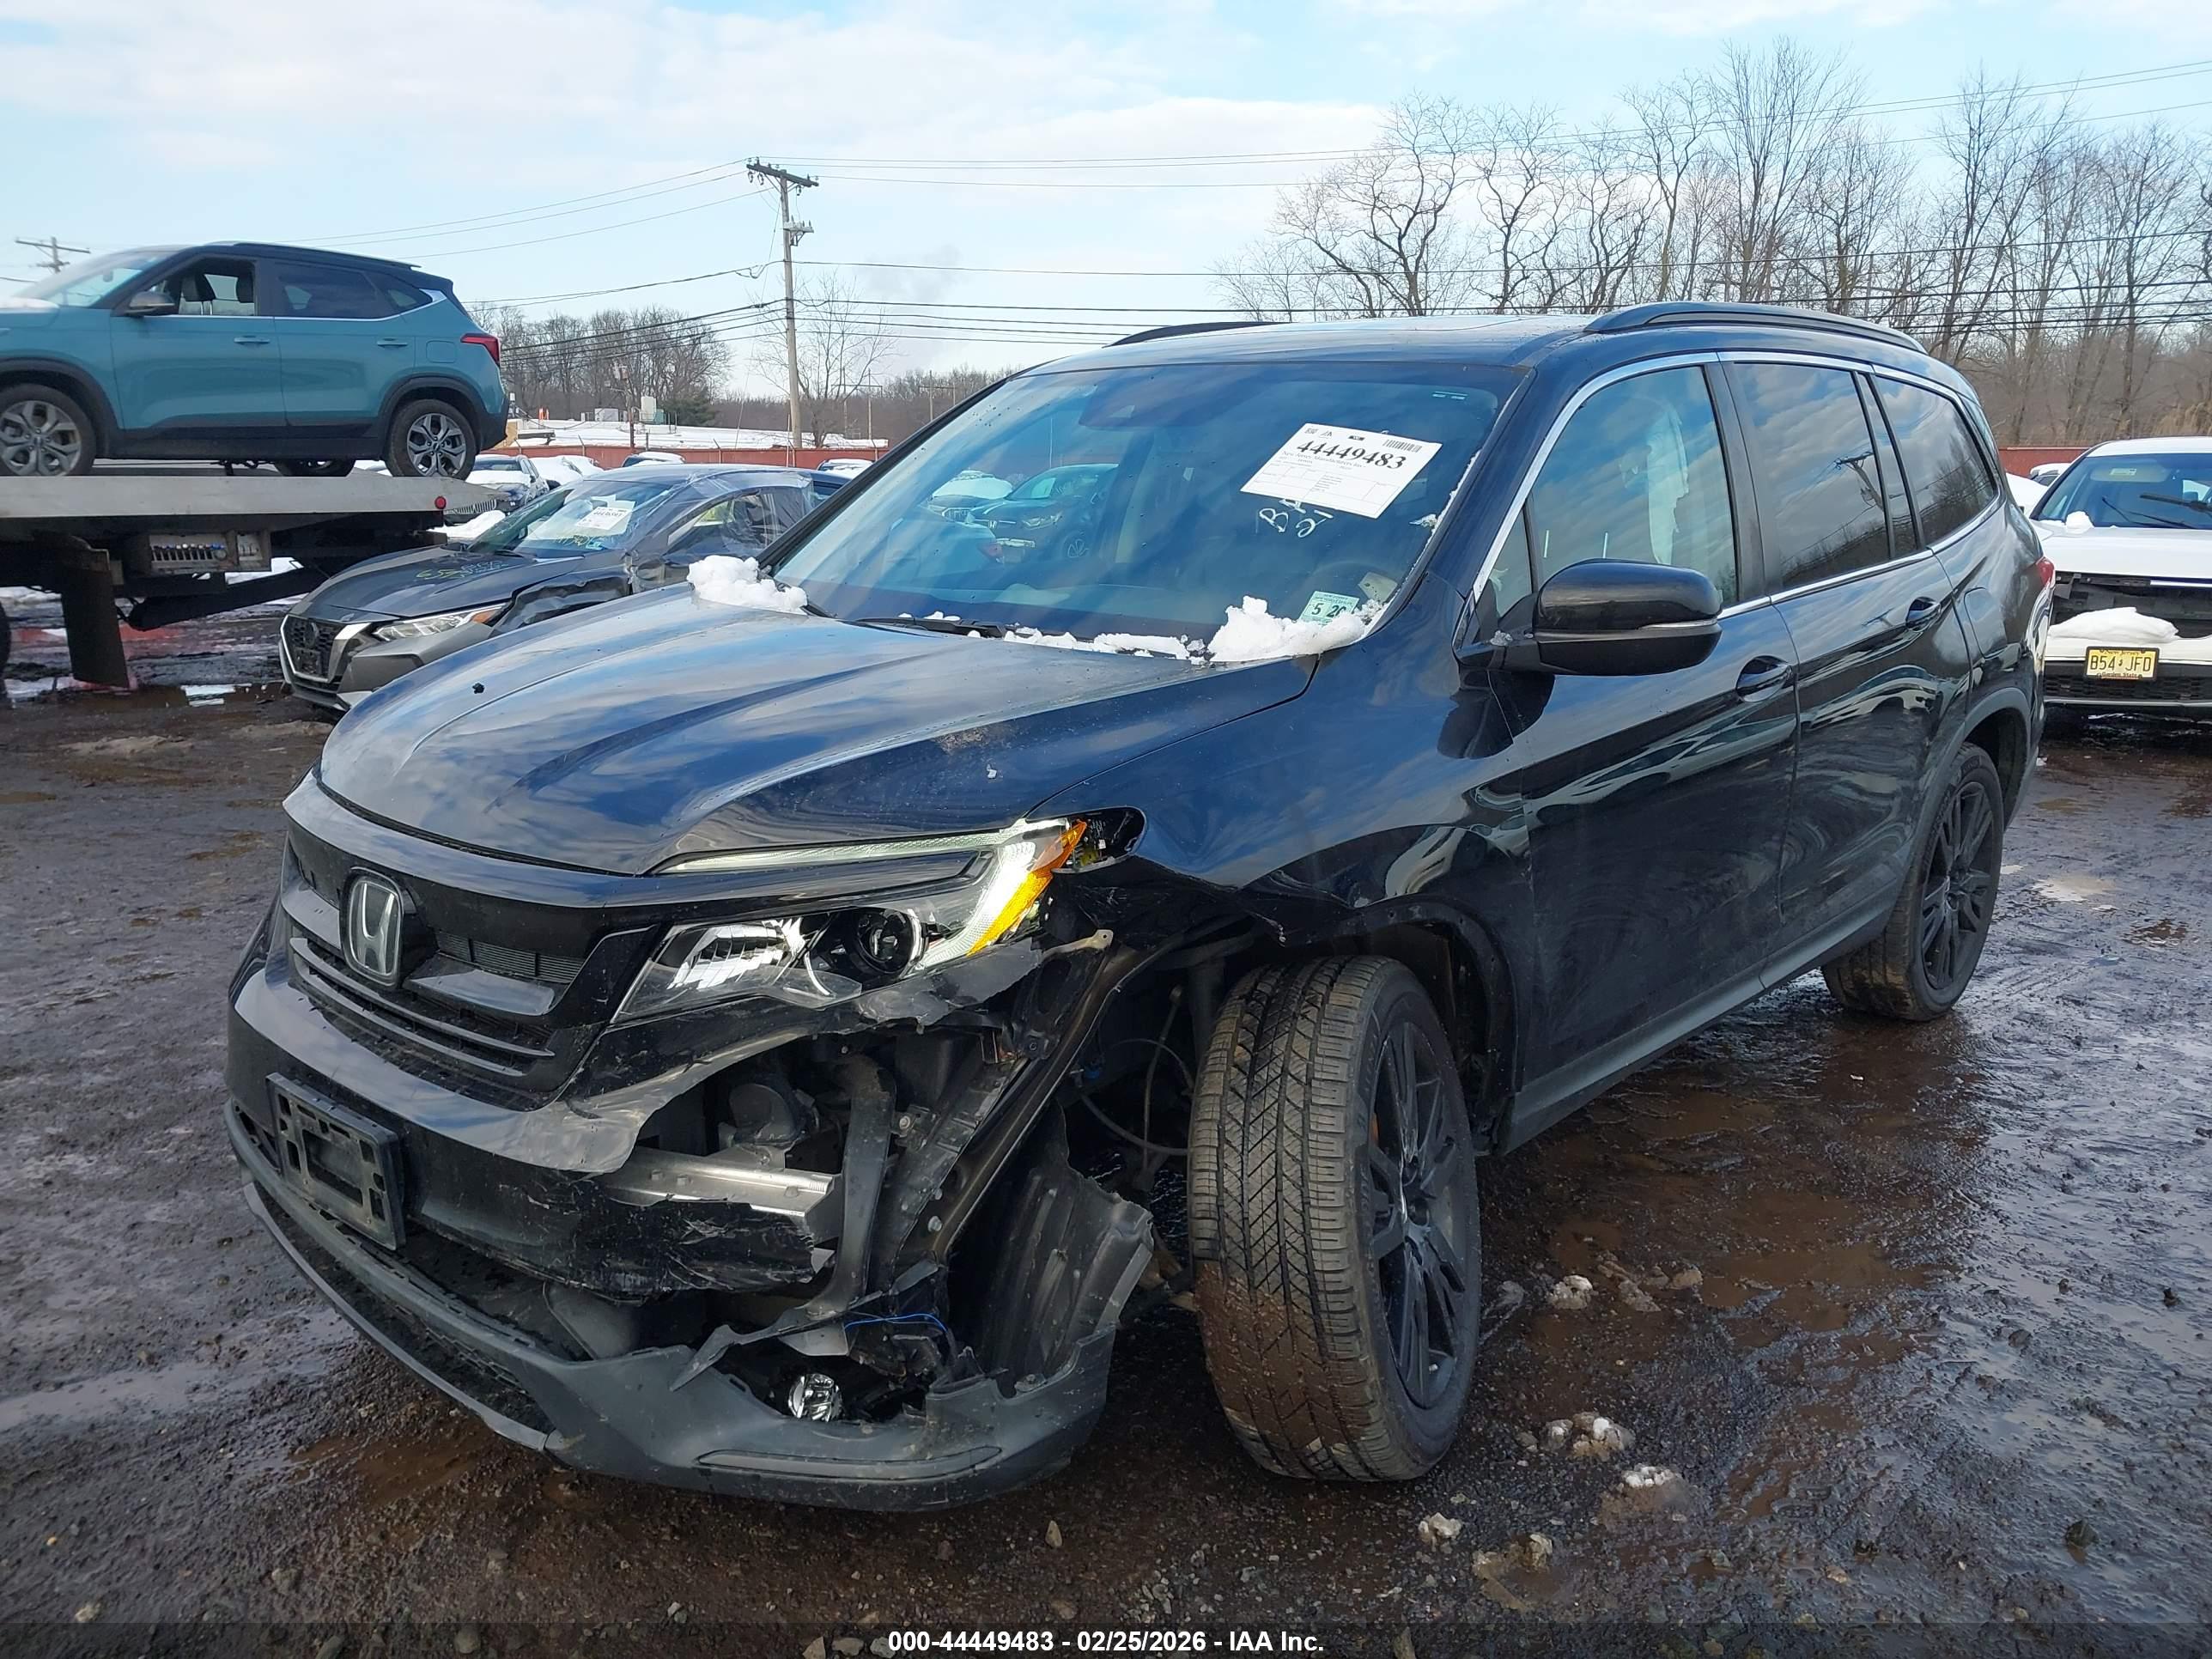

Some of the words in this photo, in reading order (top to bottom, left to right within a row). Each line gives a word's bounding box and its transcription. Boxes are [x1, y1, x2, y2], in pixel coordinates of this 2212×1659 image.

[1297, 441, 1407, 469] 44449483
[1311, 603, 1324, 615] 5
[2090, 655, 2117, 671] B54
[2125, 656, 2152, 672] JFD
